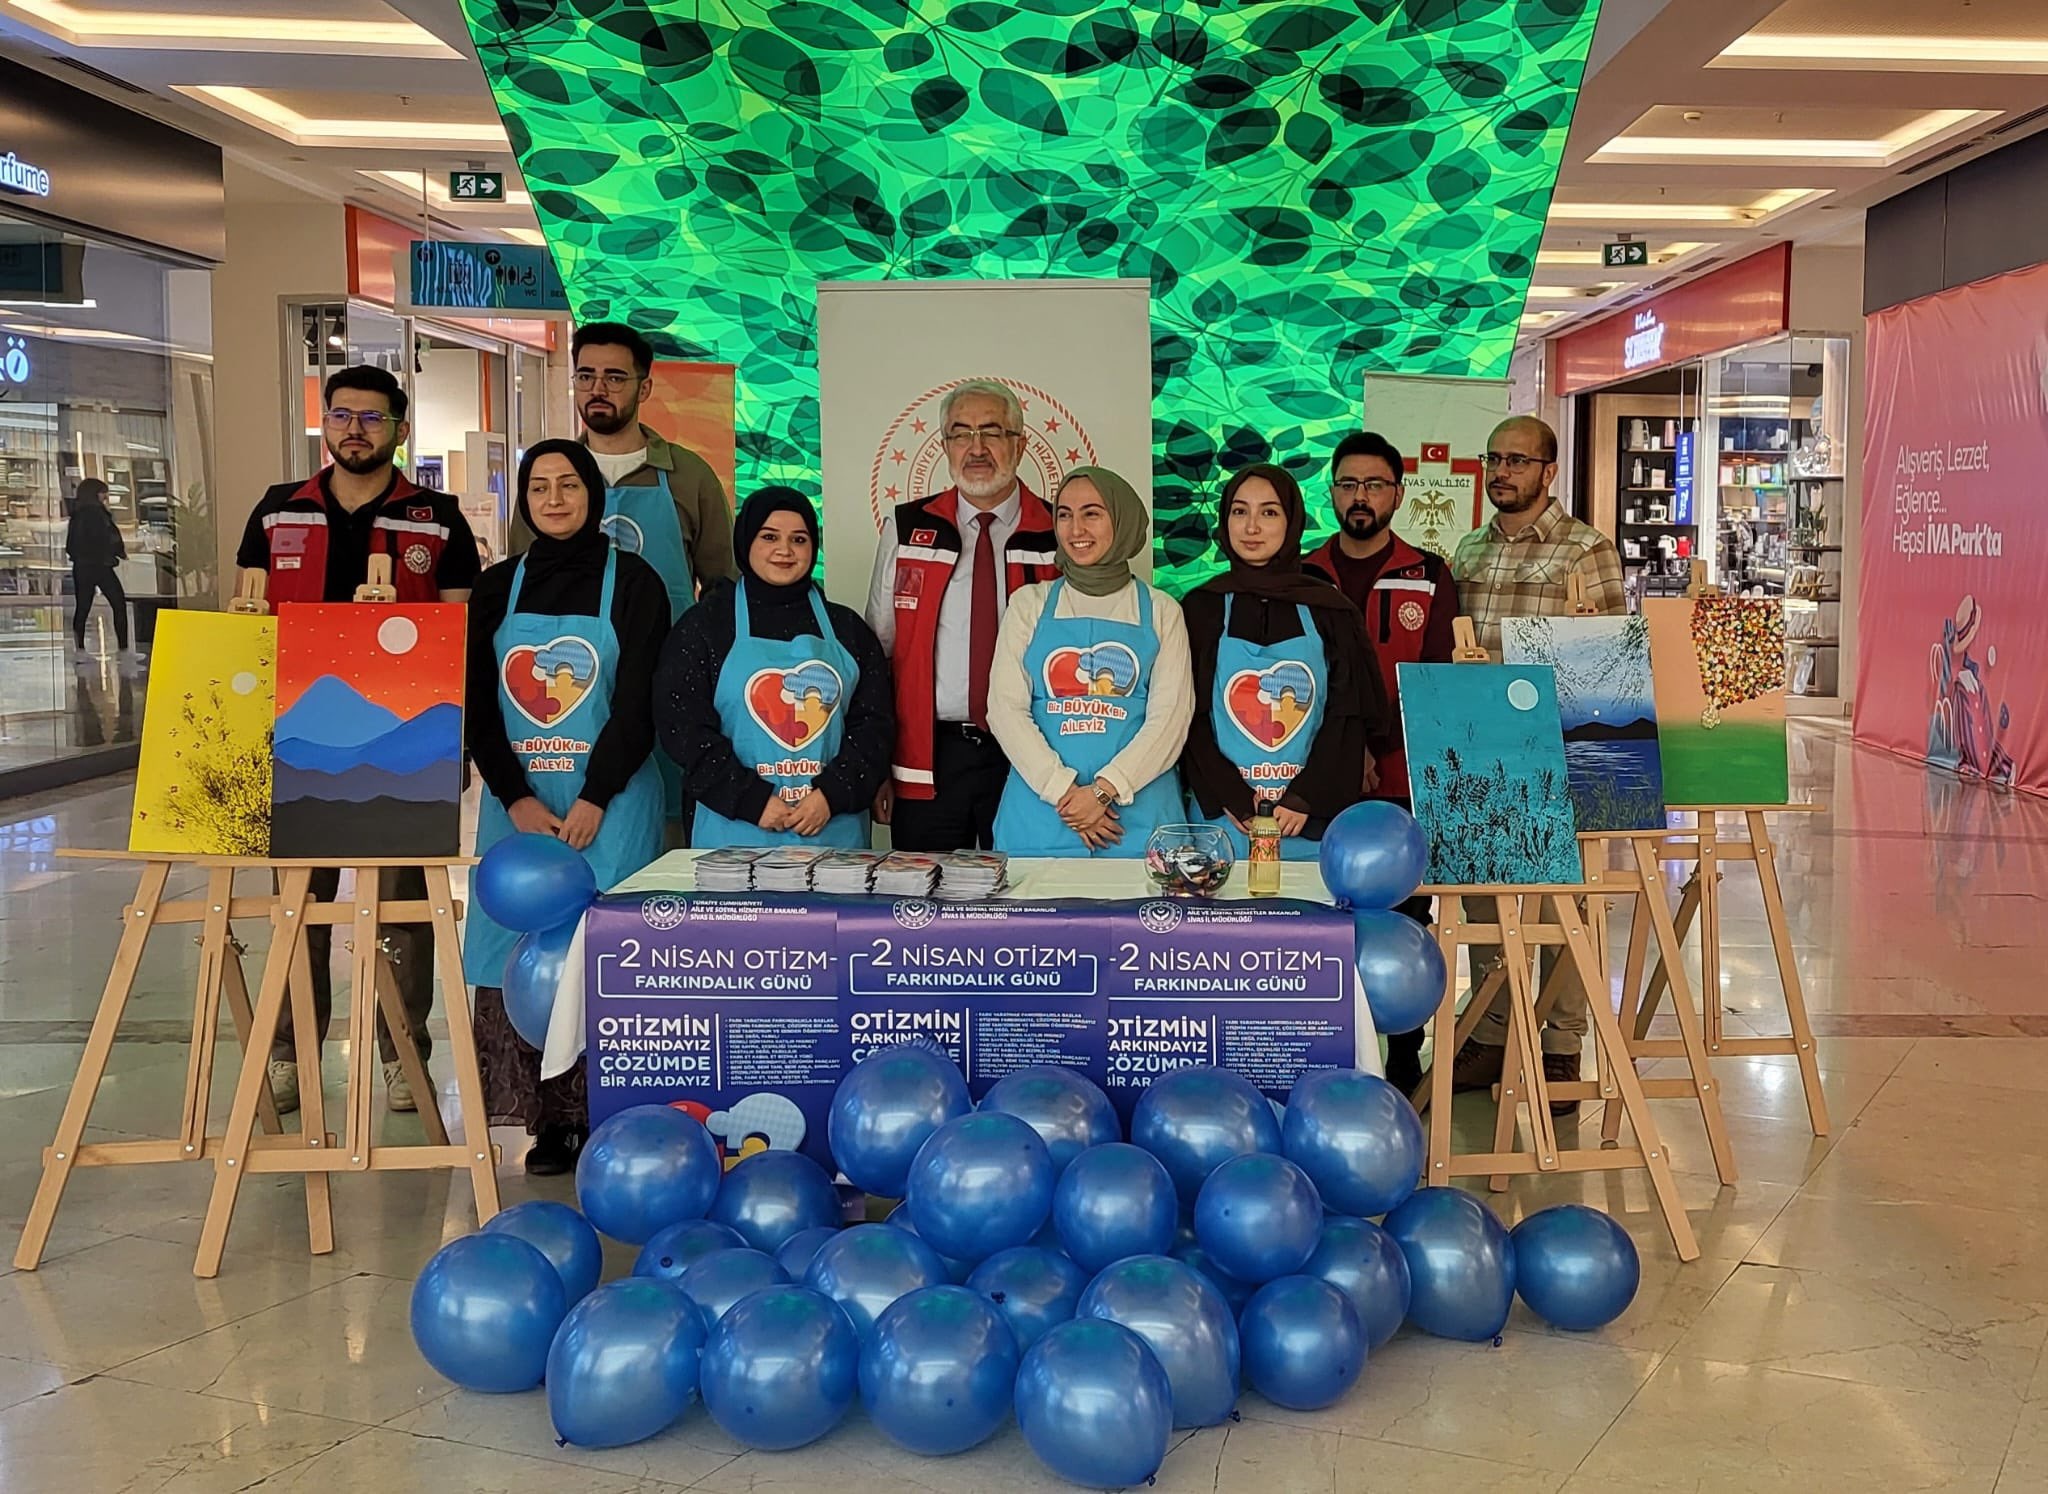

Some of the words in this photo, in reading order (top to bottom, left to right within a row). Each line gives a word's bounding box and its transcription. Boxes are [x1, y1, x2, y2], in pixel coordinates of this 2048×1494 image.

[0, 153, 48, 194] rfume
[913, 438, 942, 499] HURİYETİ
[1896, 441, 1945, 482] Alışveriş,
[1947, 440, 1990, 473] Lezzet,
[1032, 441, 1058, 501] HİZMETLE
[1402, 477, 1425, 487] İVAS
[1429, 477, 1471, 488] VALİLİĞİ
[1893, 523, 1925, 562] Hepsi
[1951, 523, 2002, 557] Park'ta
[1048, 702, 1061, 712] Biz
[1063, 698, 1112, 716] BÜYÜK
[1112, 707, 1126, 718] Bir
[1061, 718, 1105, 734] AİLEYİZ
[511, 742, 524, 752] Biz
[525, 737, 573, 752] BÜYÜK
[574, 742, 590, 752] Bir
[529, 757, 573, 771] AİLEYİZ
[758, 764, 774, 775] Biz
[776, 759, 818, 775] BÜYÜK
[1239, 768, 1249, 778] iz
[1253, 763, 1298, 778] BÜYÜK
[779, 785, 814, 801] İLEYİ
[619, 938, 641, 968] 2
[651, 944, 734, 969] NİSAN
[743, 947, 828, 970] OTİZM
[871, 938, 893, 966] 2
[902, 944, 985, 967] NİSAN
[994, 944, 1077, 967] OTİZM
[1119, 943, 1140, 971] 2
[1150, 948, 1230, 971] NİSAN
[1239, 948, 1321, 971] OTİZM
[635, 975, 755, 990] FARKINDALIK
[760, 975, 812, 990] GÜNÜ
[887, 974, 1005, 987] FARKINDALIK
[1010, 972, 1061, 987] GÜNÜ
[1134, 978, 1251, 992] FARKINDALIK
[1256, 976, 1307, 992] GÜNÜ
[598, 1013, 710, 1036] OTİZMİN
[850, 1009, 960, 1030] OTİZMİN
[599, 1039, 711, 1051] FARKINDAYIZ
[851, 1032, 960, 1044] FARKINDYIZ
[1108, 1040, 1208, 1053] ARKINDAYIZ
[599, 1053, 711, 1074] ÇÖZÜMDE
[600, 1073, 626, 1087] BİR
[631, 1075, 711, 1087] ARADAYIZ
